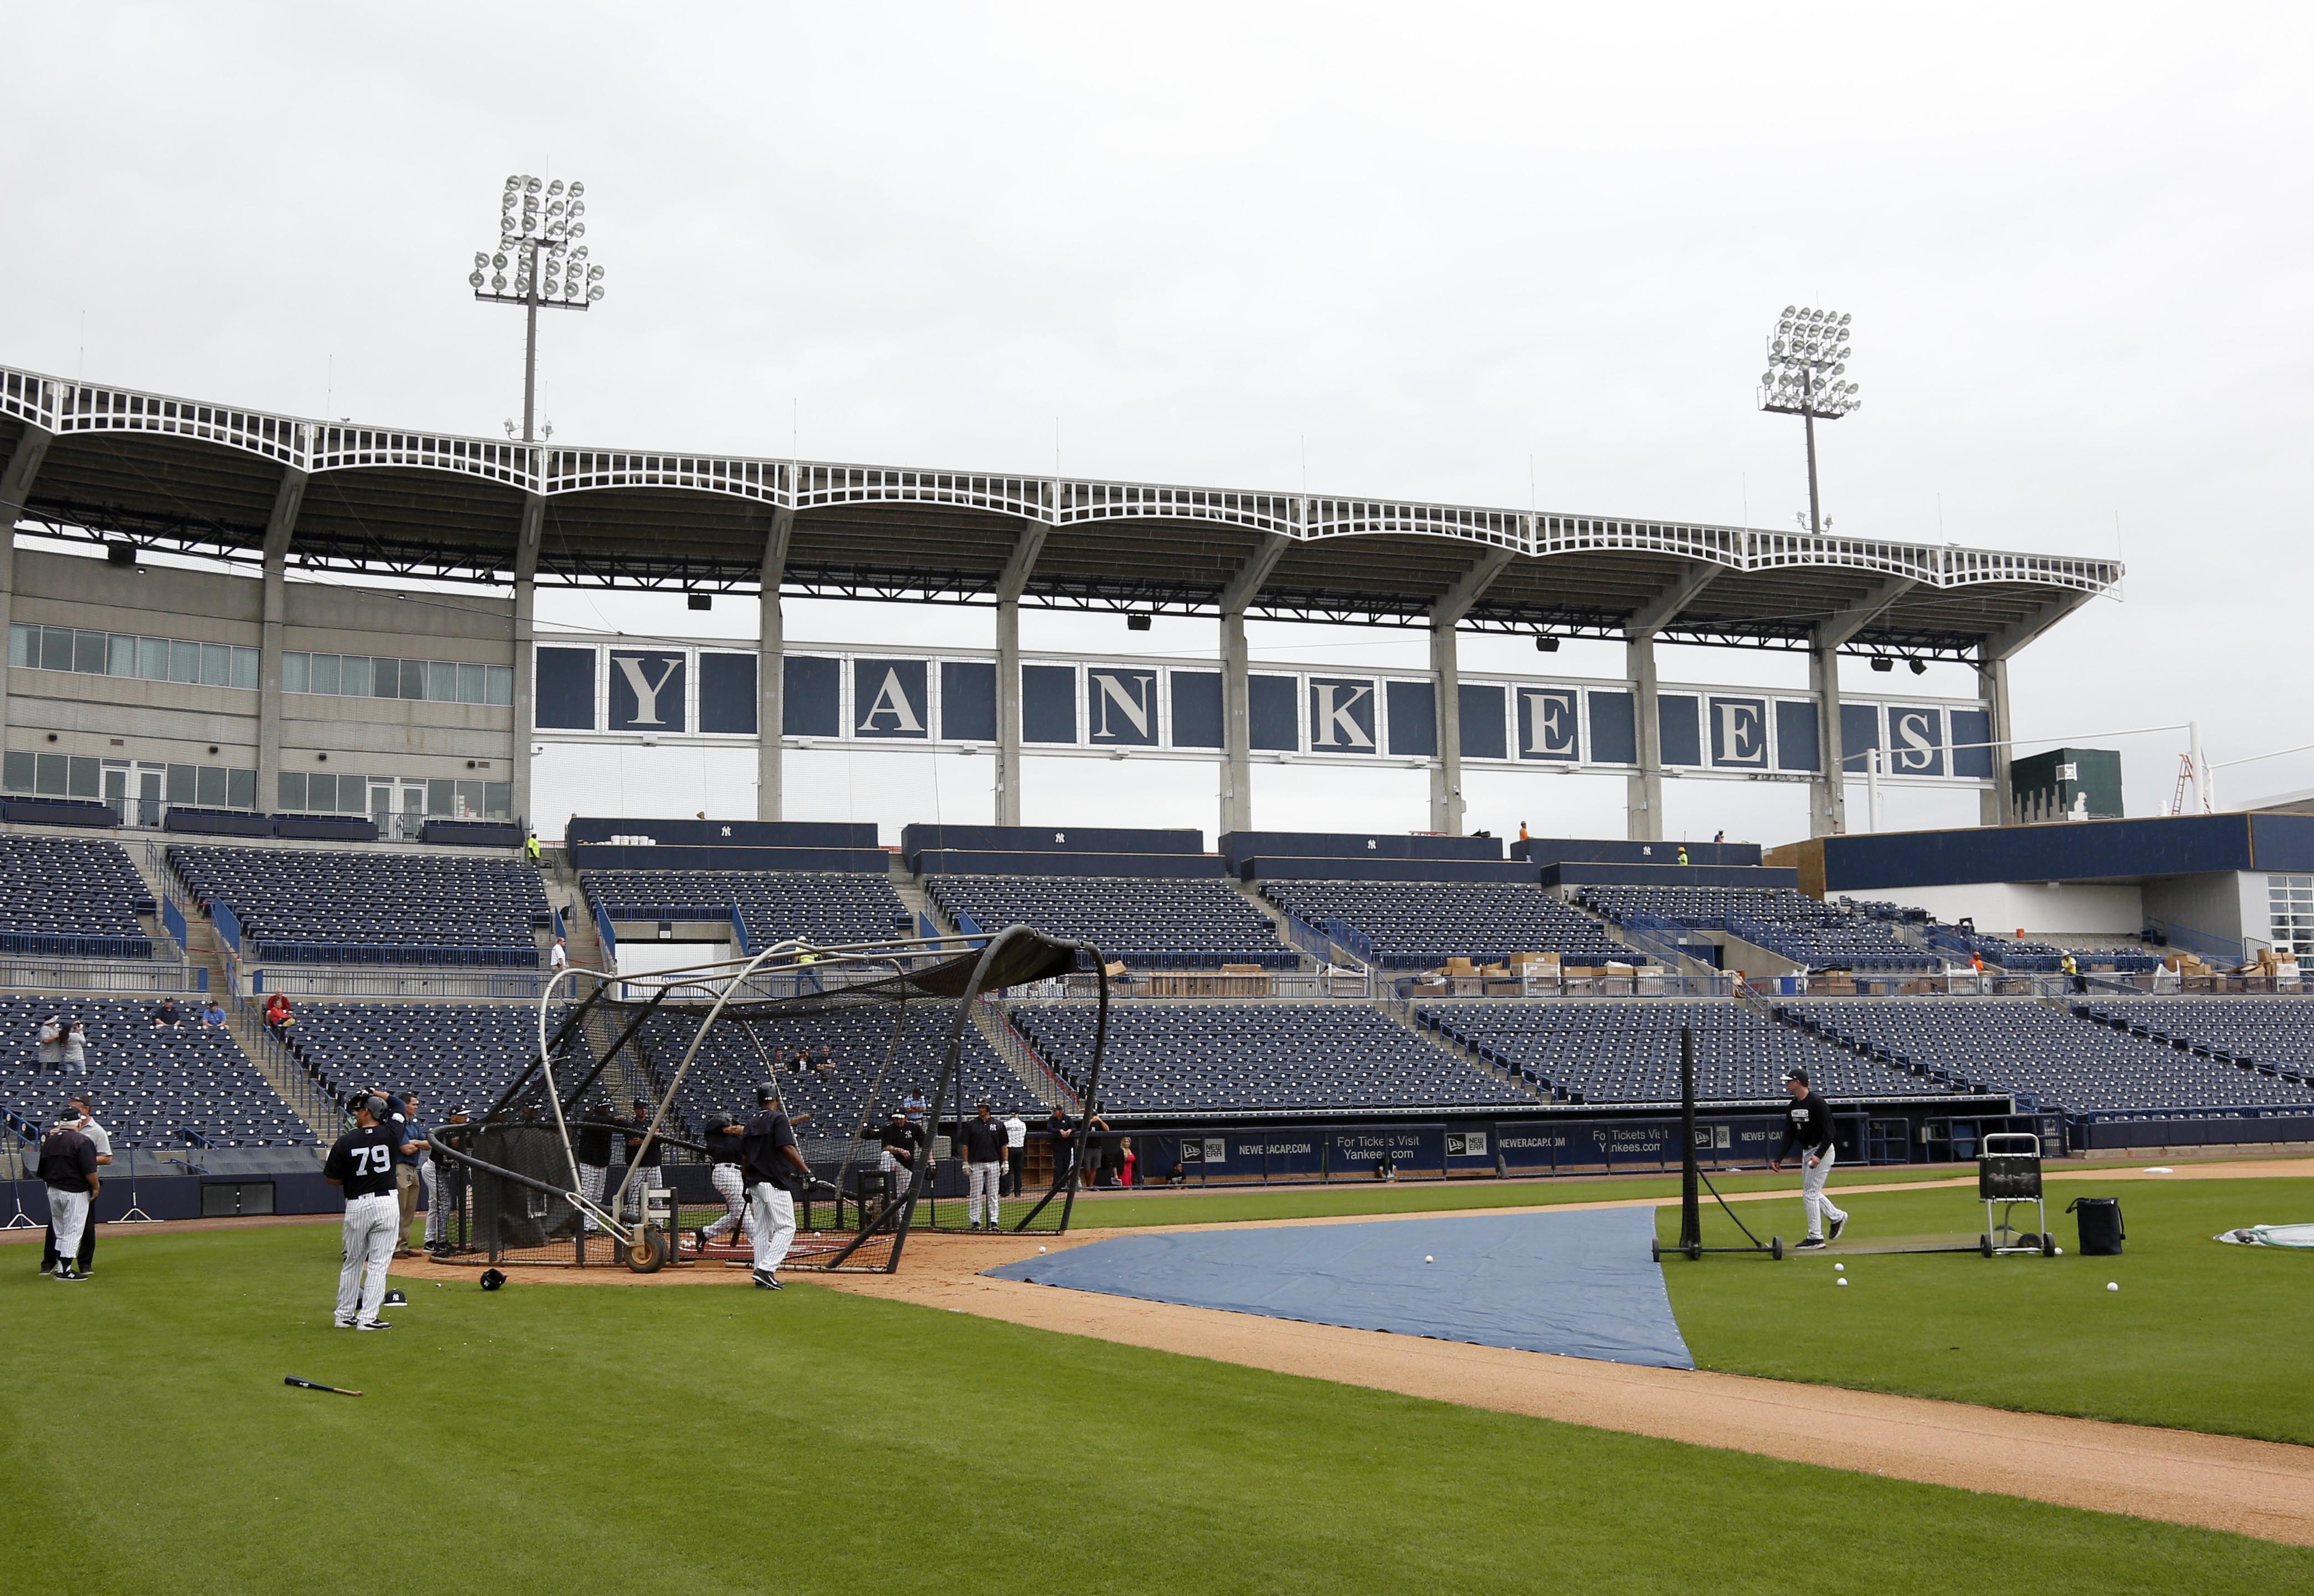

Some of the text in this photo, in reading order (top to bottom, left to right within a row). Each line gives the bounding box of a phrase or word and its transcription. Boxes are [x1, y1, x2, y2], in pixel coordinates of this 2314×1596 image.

[1593, 1129, 1668, 1140] Fo Tickets Vist
[1337, 1135, 1420, 1147] For Tickes Visit
[1599, 1142, 1661, 1152] Ynkees.com
[351, 1144, 391, 1176] 79
[1344, 1149, 1413, 1160] Yankeecom
